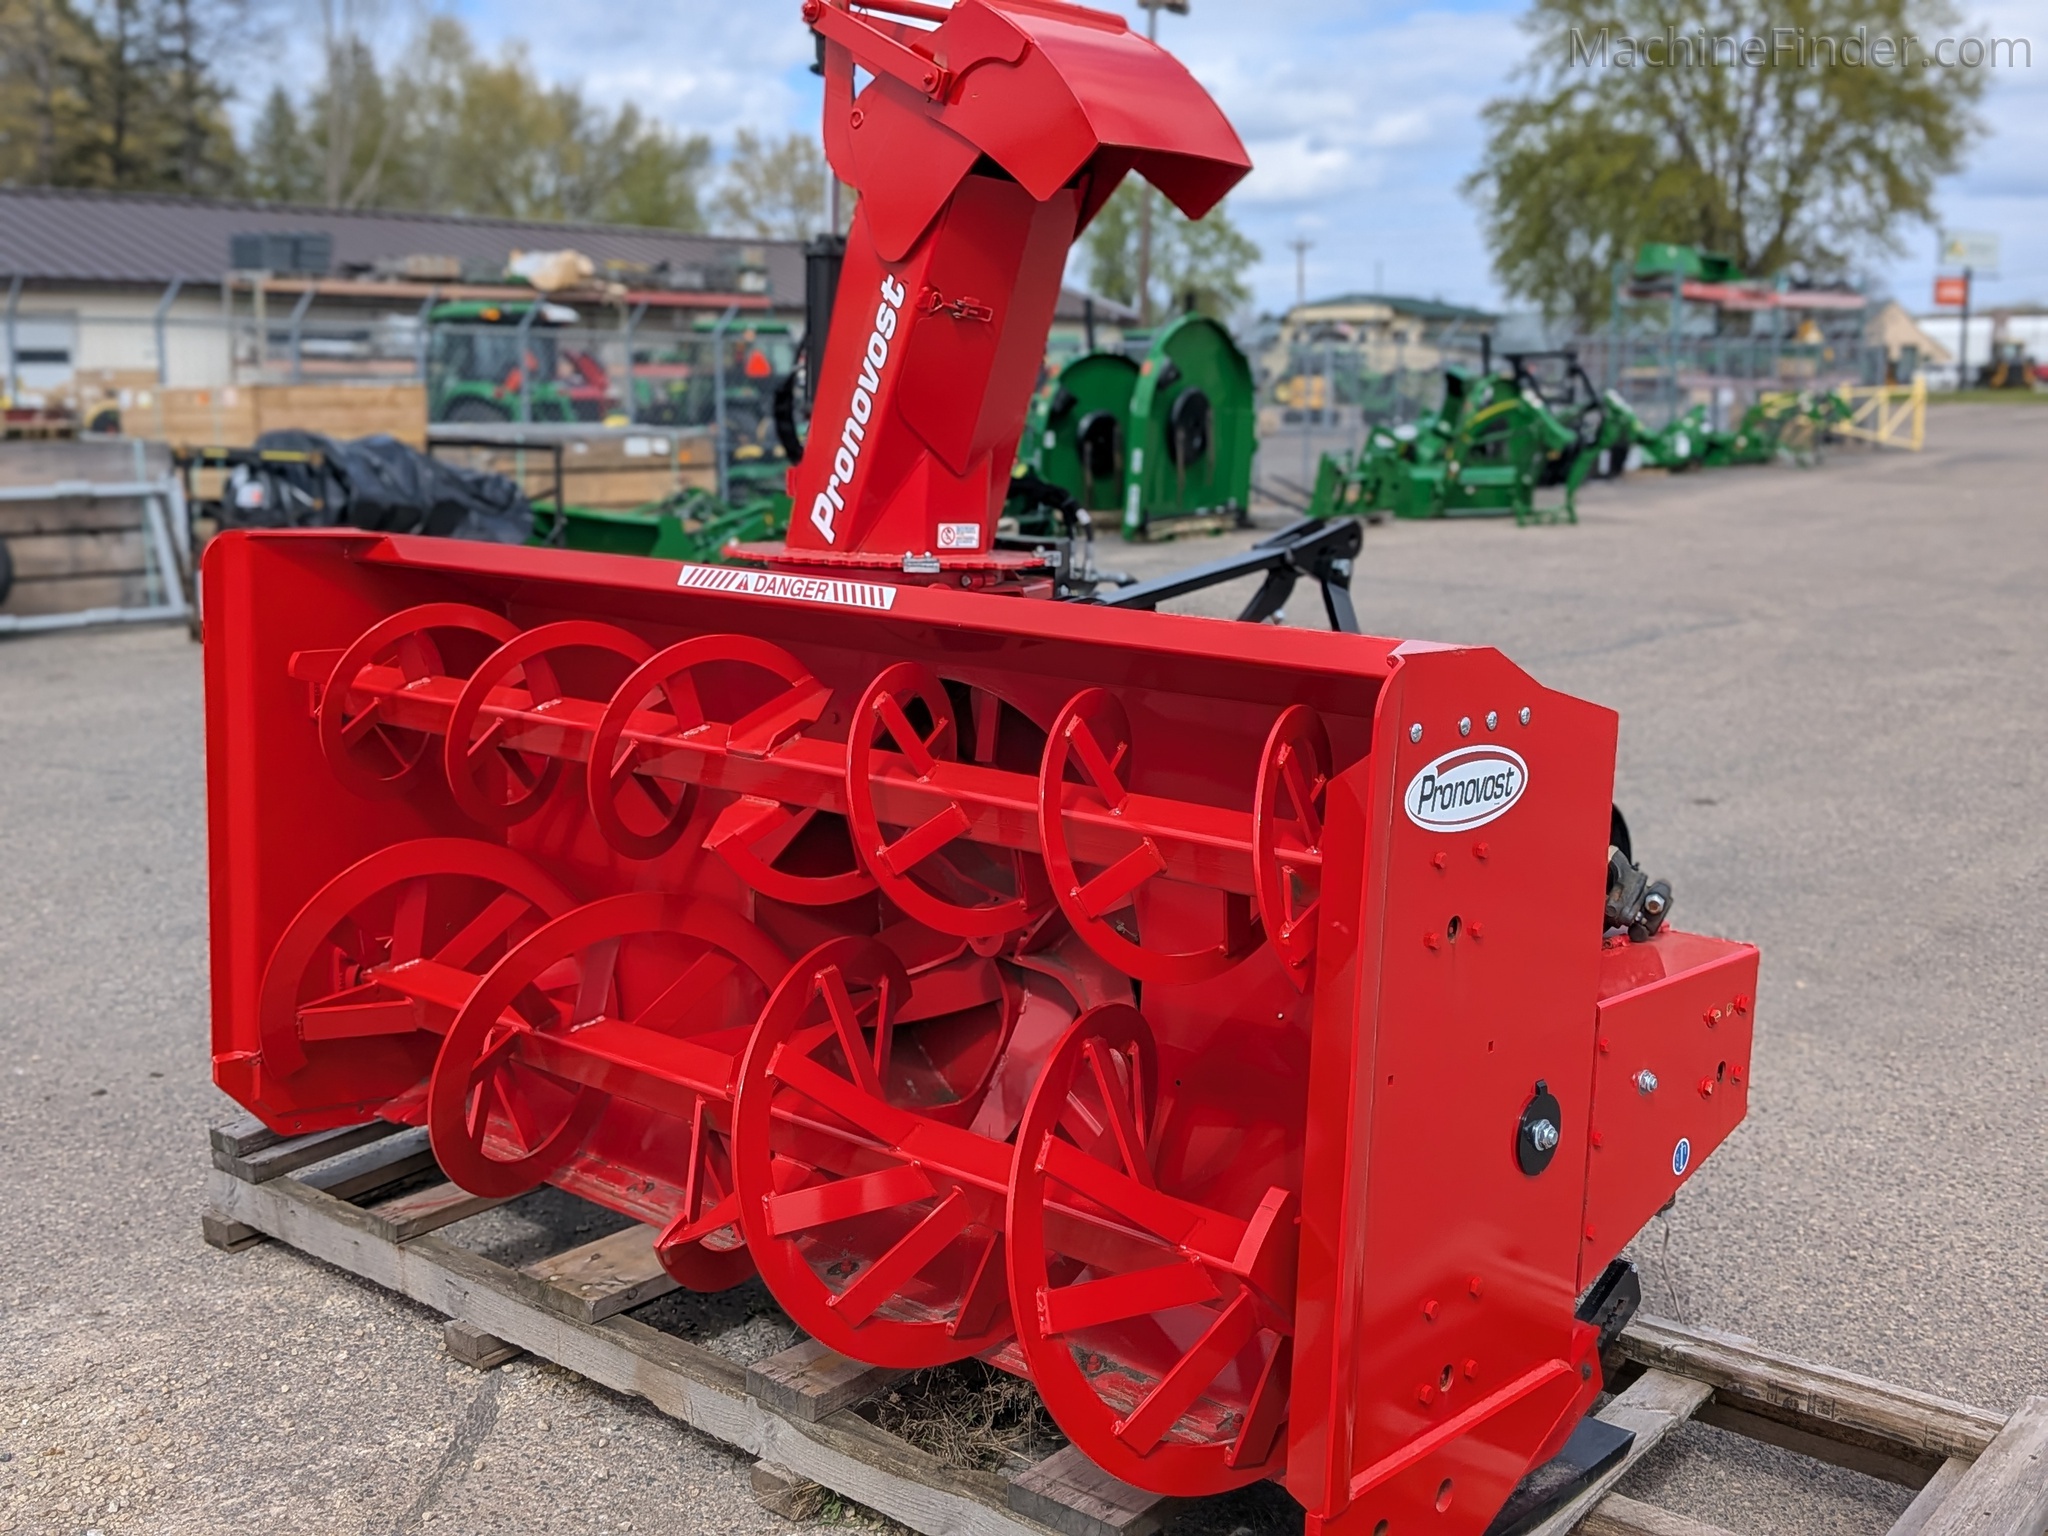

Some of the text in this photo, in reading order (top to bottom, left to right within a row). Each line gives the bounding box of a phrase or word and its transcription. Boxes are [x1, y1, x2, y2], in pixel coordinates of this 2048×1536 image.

[810, 274, 905, 544] Pronovost
[753, 575, 829, 600] DANGER
[1418, 767, 1514, 815] Pronovost
